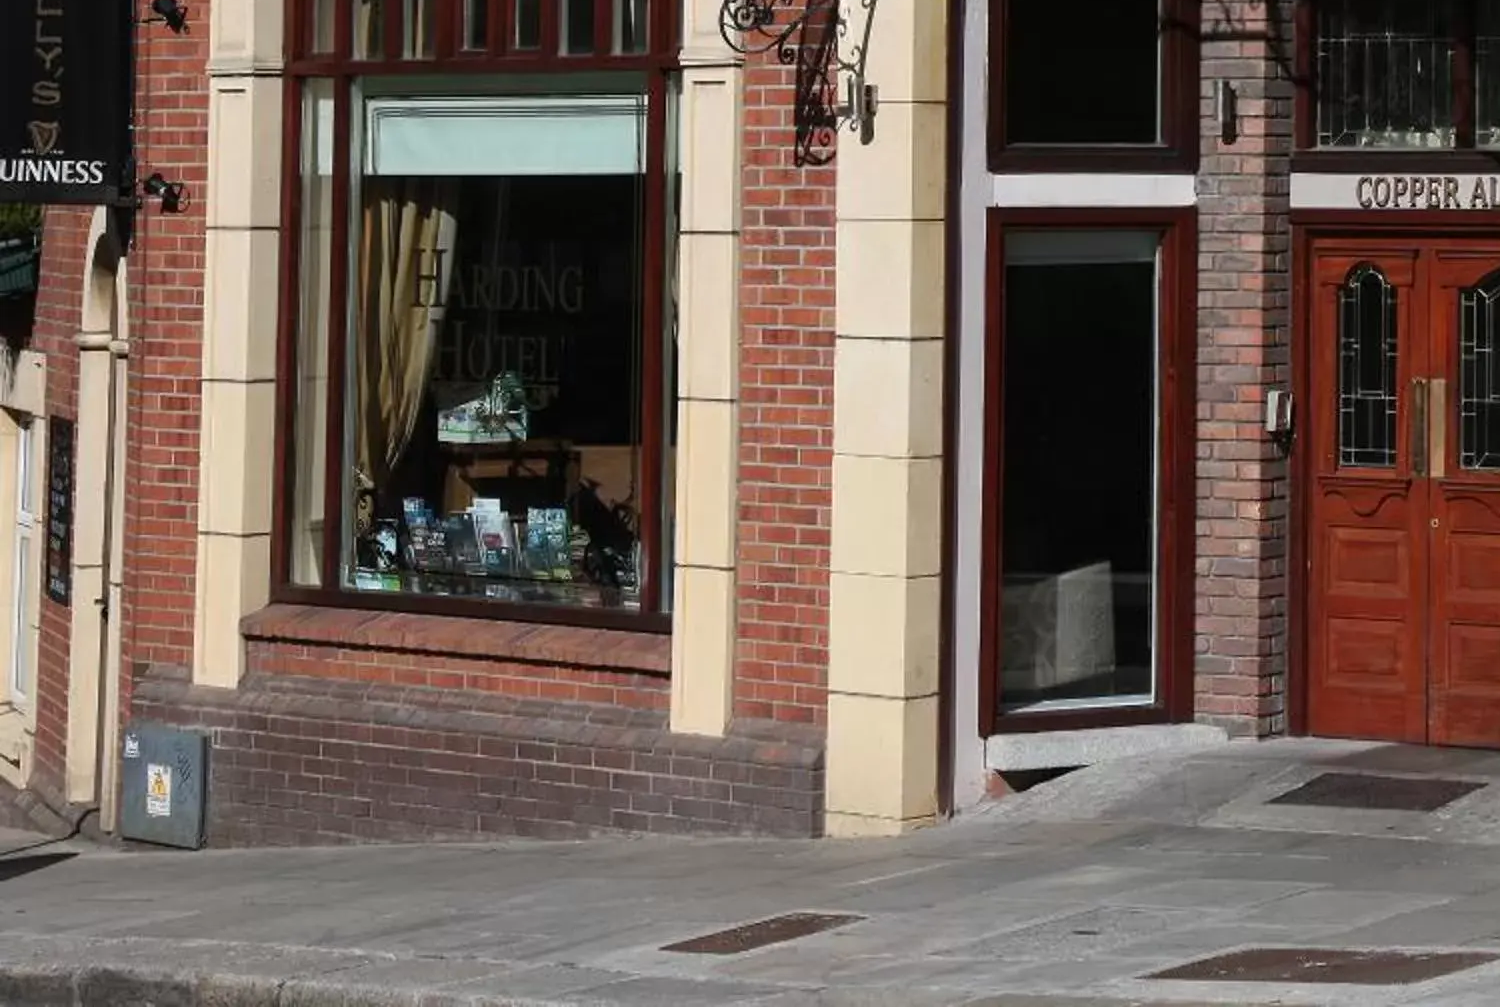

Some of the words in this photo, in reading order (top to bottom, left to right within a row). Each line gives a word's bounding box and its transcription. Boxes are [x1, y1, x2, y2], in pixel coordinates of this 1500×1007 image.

[0, 159, 104, 184] UINNESS
[1356, 176, 1461, 209] COPPER
[411, 249, 584, 313] HARDING
[431, 318, 560, 382] HOTEL
